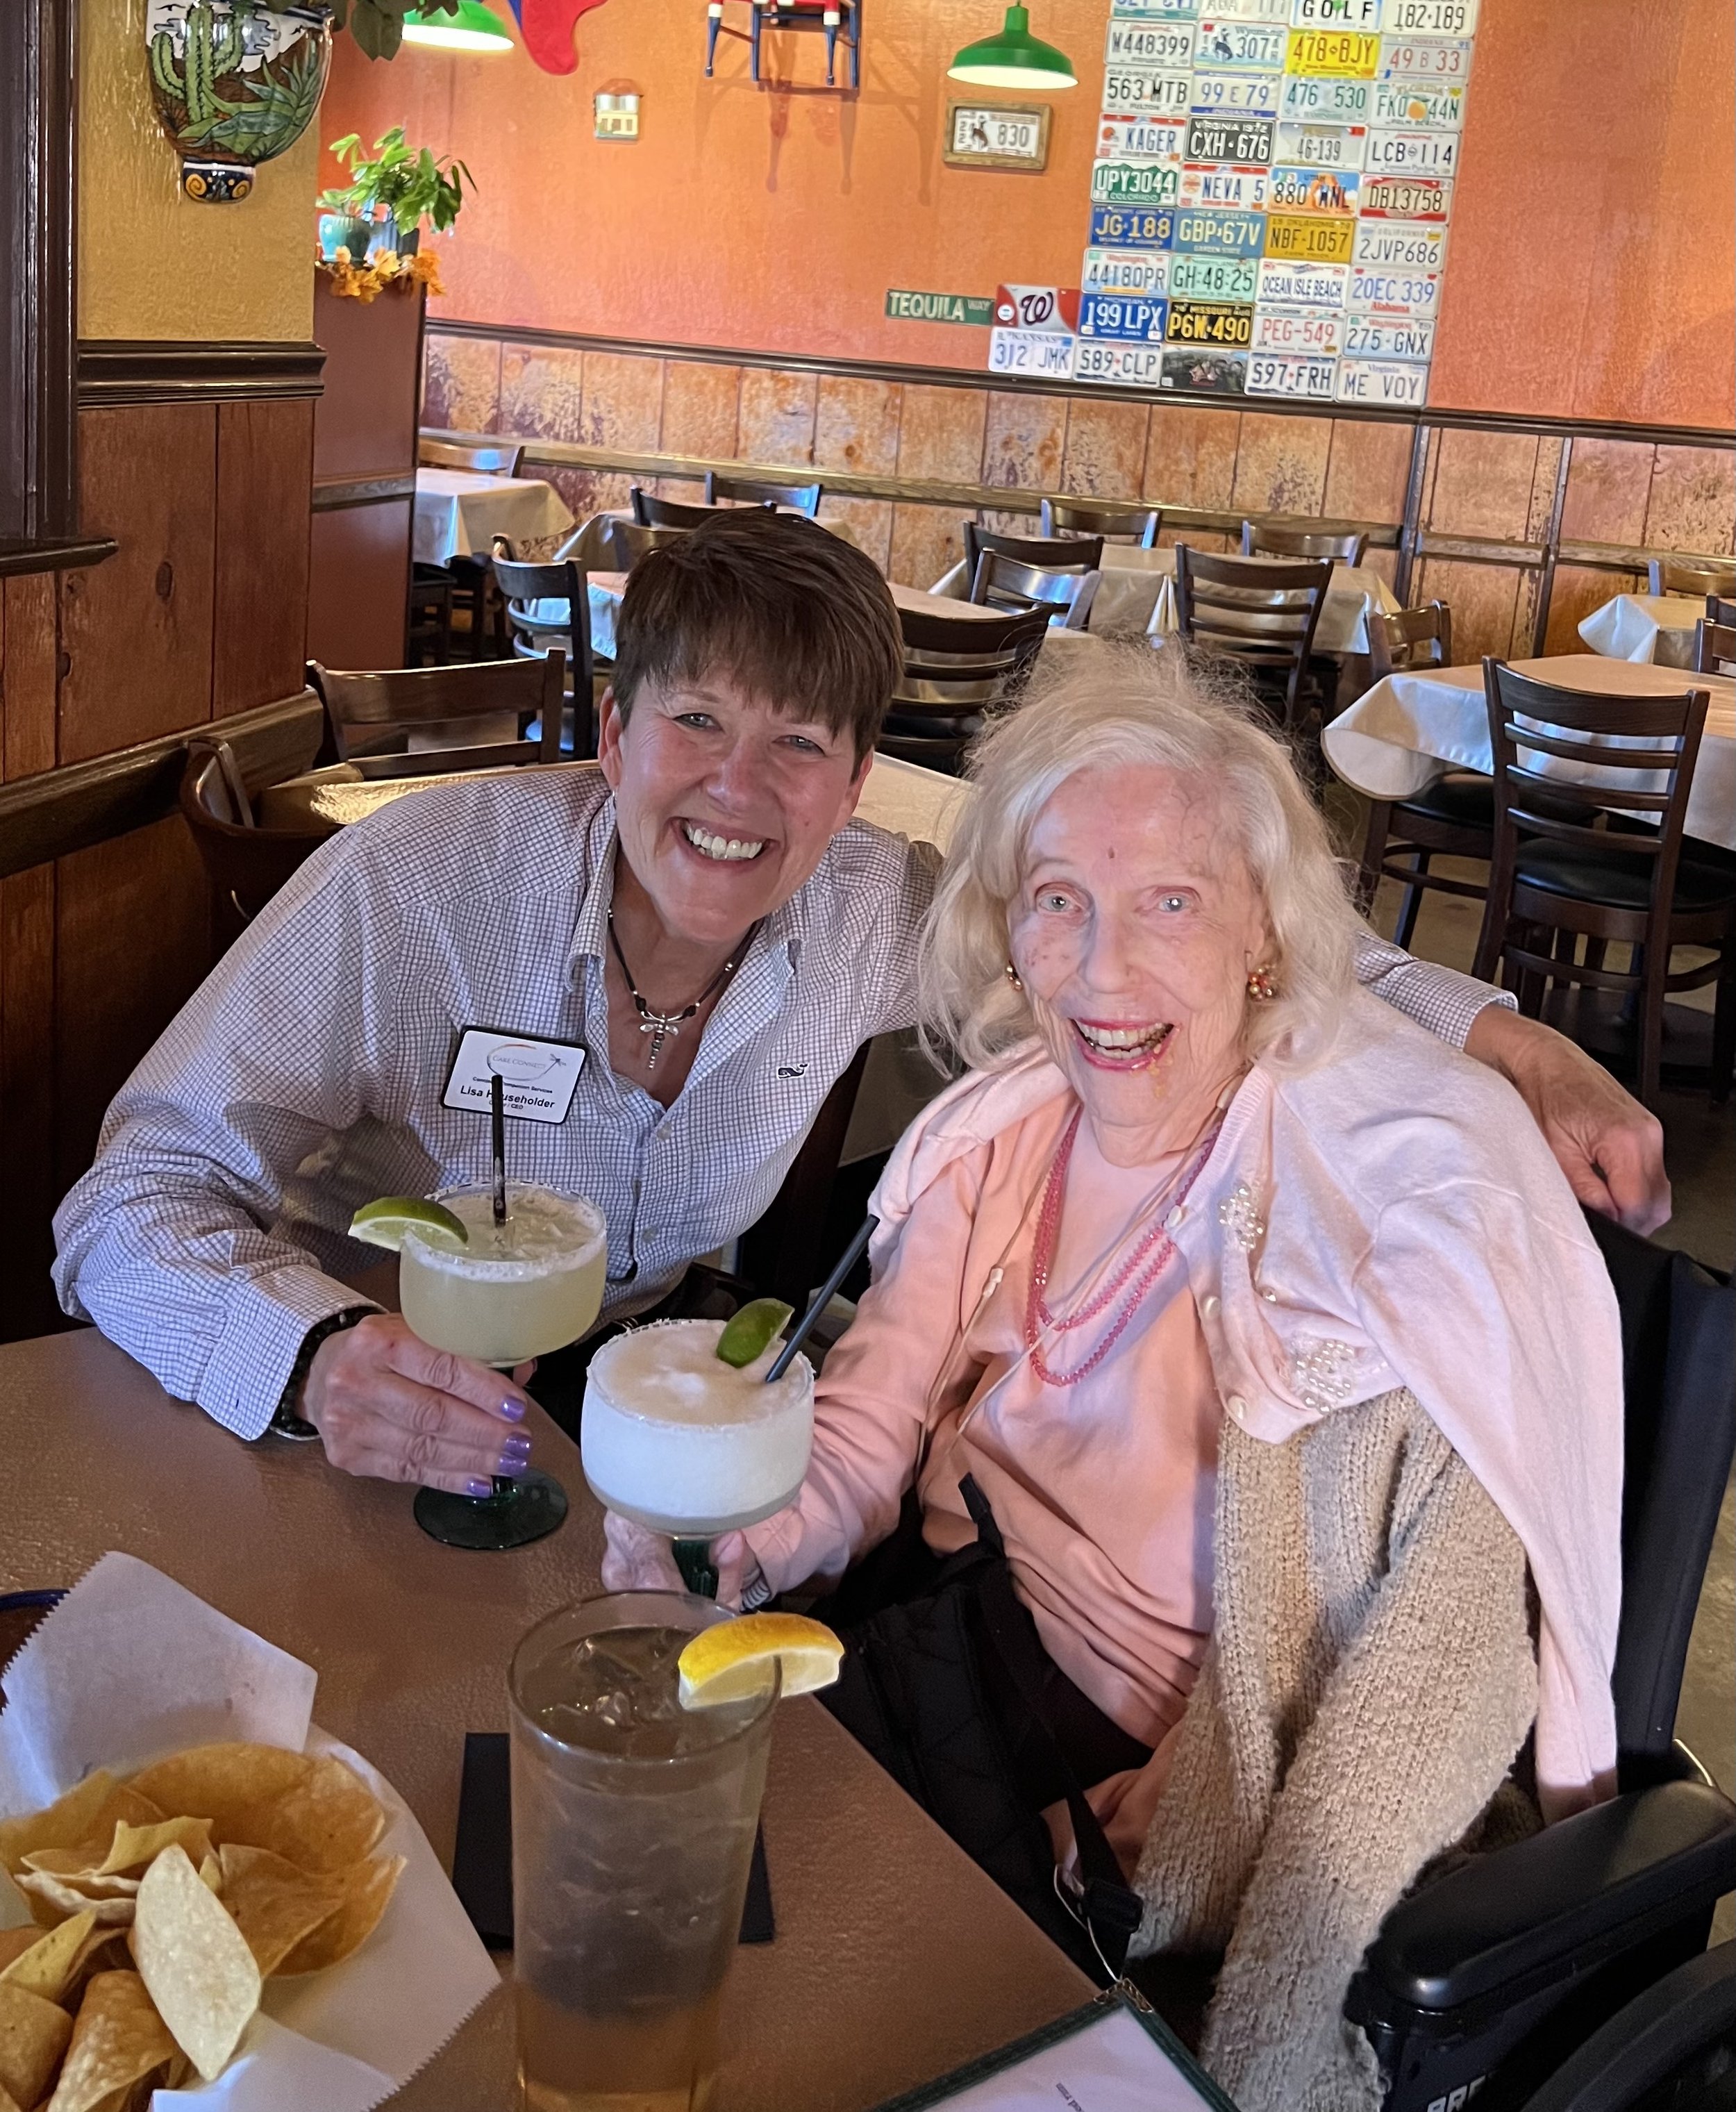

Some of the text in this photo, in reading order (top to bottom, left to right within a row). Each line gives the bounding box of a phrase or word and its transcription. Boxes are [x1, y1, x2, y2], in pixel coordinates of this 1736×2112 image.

[1235, 37, 1269, 60] 307
[1390, 48, 1413, 69] 49
[1436, 50, 1460, 71] 33
[1108, 77, 1144, 100] 563
[1201, 83, 1269, 106] 99 E 79
[1287, 83, 1366, 109] 476 530
[997, 124, 1029, 147] 830
[1372, 141, 1406, 162] LCB
[1096, 169, 1174, 194] UPY3044
[1202, 176, 1265, 201] NEVA 5
[1274, 182, 1307, 205] 880
[1360, 238, 1439, 264] 2JVP686
[1262, 276, 1342, 297] OCEAN ISLE BEACH
[1401, 281, 1435, 304] 339
[890, 292, 990, 322] TEQUILA WAY
[1086, 301, 1163, 331] 199 LPX
[1190, 305, 1232, 316] MISSOURI
[1368, 363, 1401, 374] Virginia
[1344, 372, 1419, 400] ME VOY
[460, 1085, 483, 1097] Lisa
